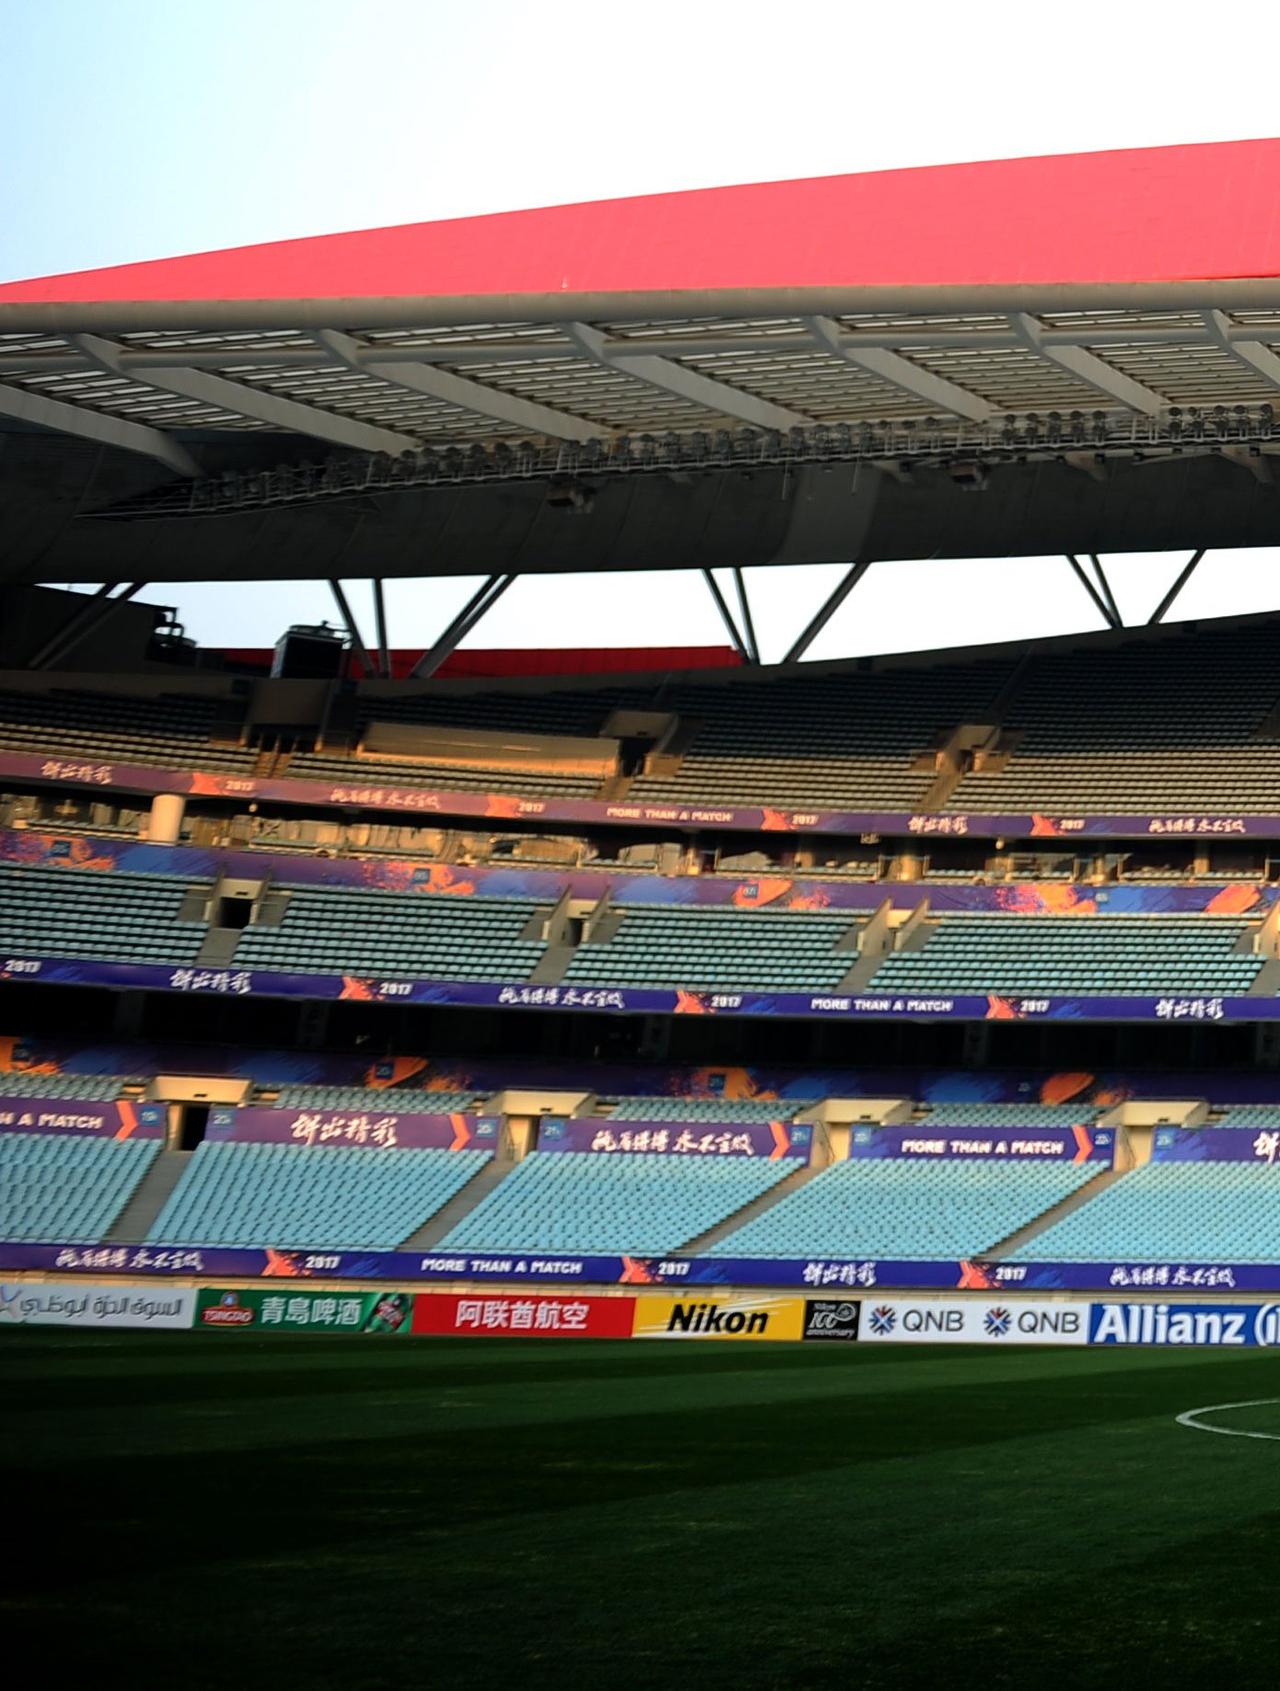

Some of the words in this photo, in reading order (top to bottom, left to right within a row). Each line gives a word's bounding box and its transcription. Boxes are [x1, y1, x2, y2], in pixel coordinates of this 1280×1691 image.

[18, 1114, 32, 1125] A
[38, 1114, 103, 1128] MATCH
[902, 1140, 946, 1153] MORE
[950, 1141, 992, 1153] THAN
[995, 1141, 1007, 1153] A
[1011, 1141, 1063, 1154] MATCH
[306, 1256, 340, 1268] 2017
[422, 1259, 465, 1271] MORE
[471, 1260, 511, 1271] THAN
[515, 1261, 526, 1272] A
[531, 1262, 581, 1273] MATCH
[658, 1262, 689, 1280] 2017
[456, 1300, 589, 1329] 阿联酋航空
[667, 1304, 768, 1333] Nikon
[903, 1311, 963, 1332] QNB
[1018, 1311, 1079, 1333] QNB
[1095, 1303, 1248, 1343] Allianz
